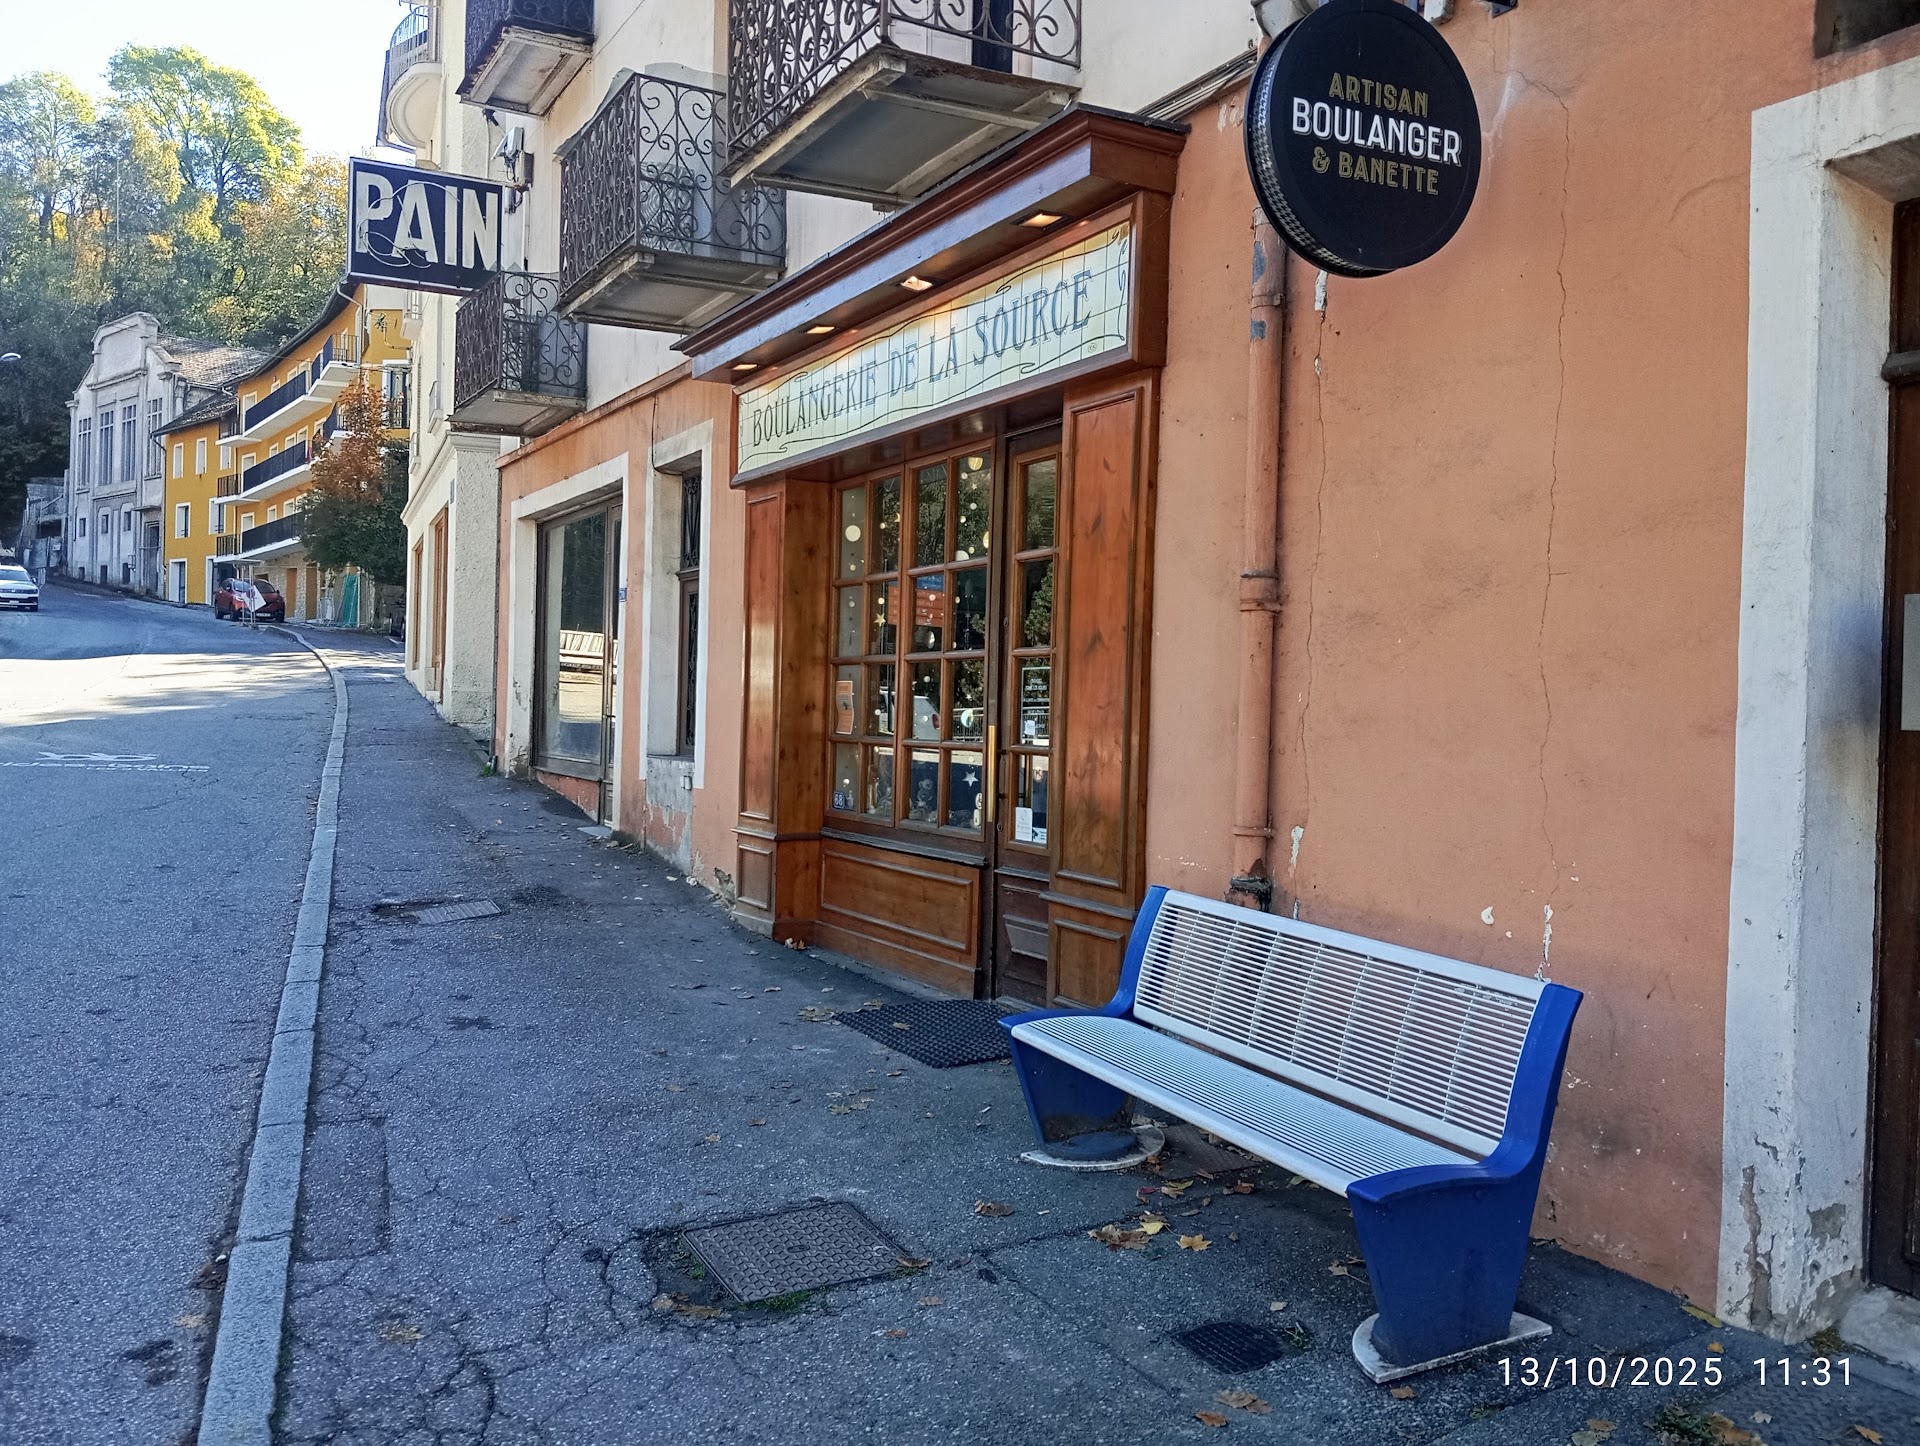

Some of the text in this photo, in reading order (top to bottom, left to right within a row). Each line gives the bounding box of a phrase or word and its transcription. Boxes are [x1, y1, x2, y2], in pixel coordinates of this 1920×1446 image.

[1328, 71, 1429, 118] ARTISAN
[1292, 97, 1462, 167] BOULANGER
[1312, 146, 1439, 195] & BANETTE
[355, 170, 498, 272] PAIN
[753, 269, 1094, 447] BOULANGERIE DE LA SOURCE
